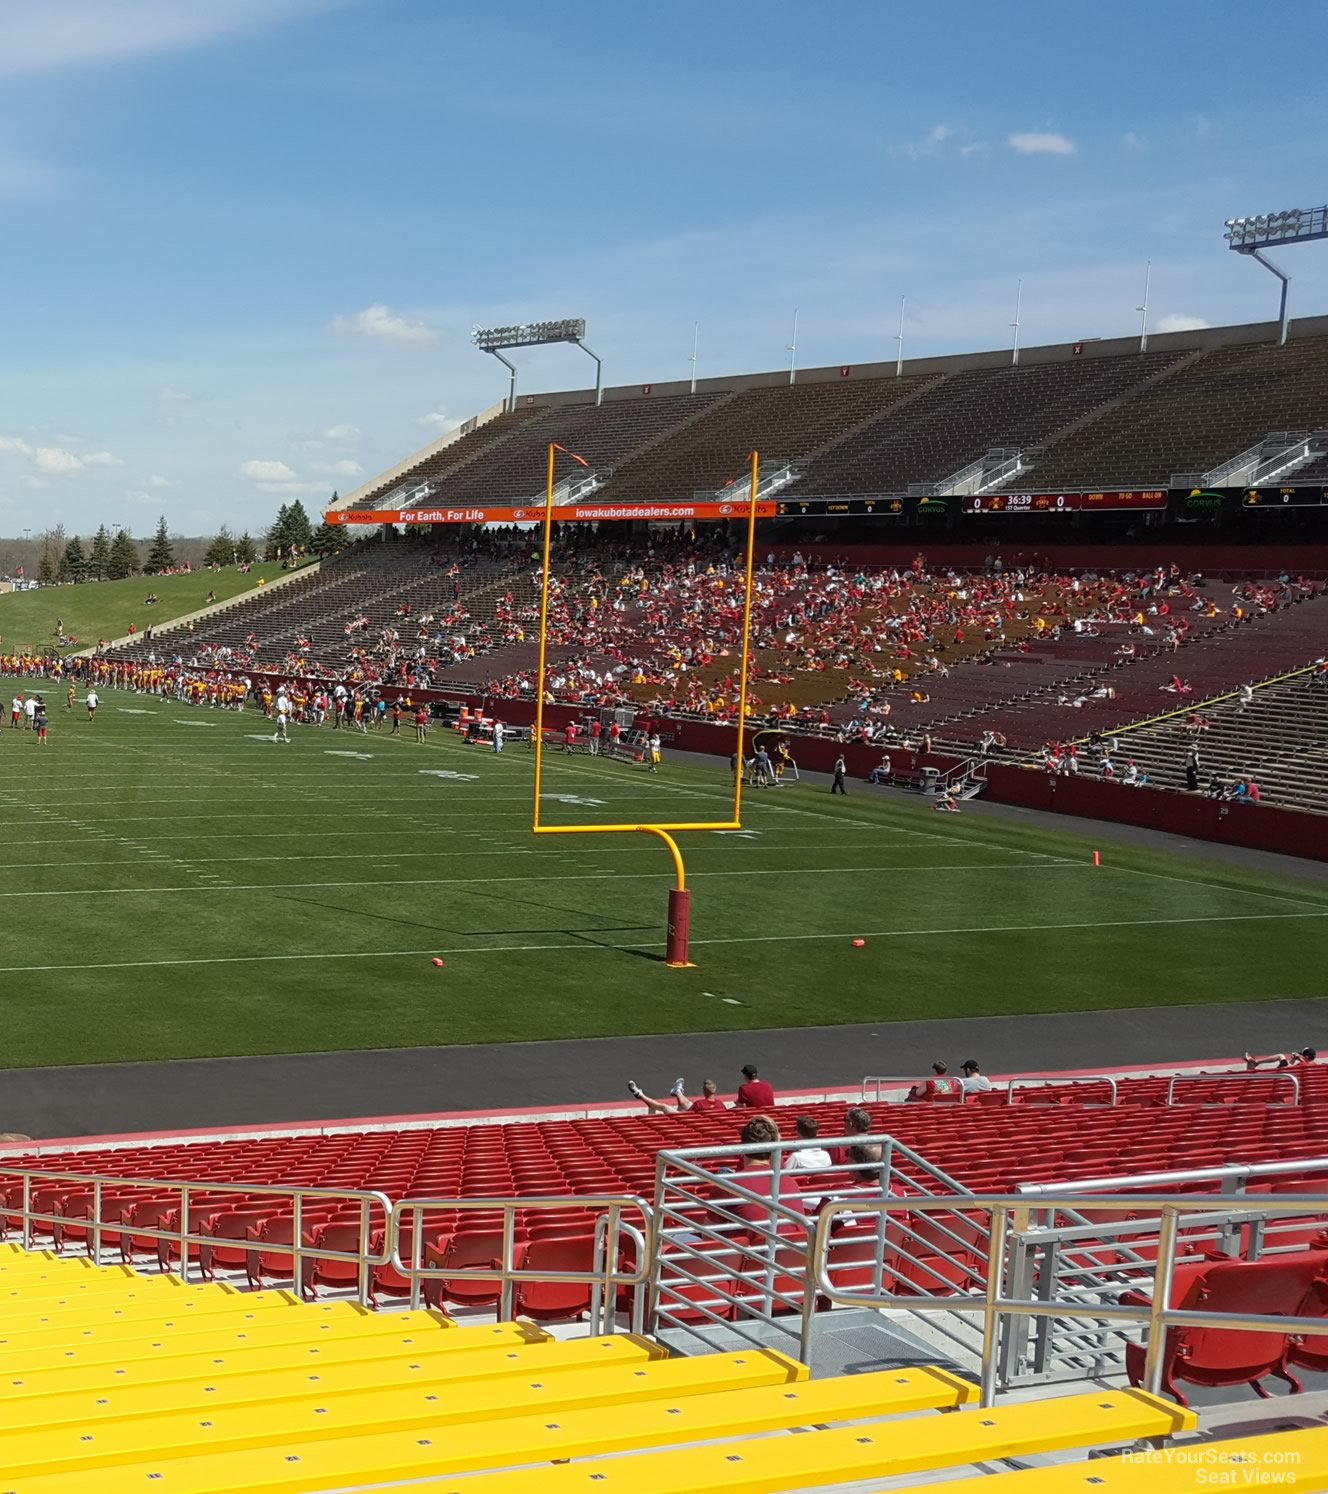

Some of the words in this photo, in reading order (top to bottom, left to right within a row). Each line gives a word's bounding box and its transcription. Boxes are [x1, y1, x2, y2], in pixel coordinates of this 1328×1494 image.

[974, 498, 981, 508] 0
[1008, 495, 1032, 505] 36:39
[1057, 496, 1064, 506] 0
[576, 507, 694, 518] iowakubotadealers.com
[733, 504, 767, 513] Kubta
[400, 511, 414, 521] For
[417, 511, 445, 522] Earth,
[447, 511, 463, 520] For
[466, 510, 484, 520] Life
